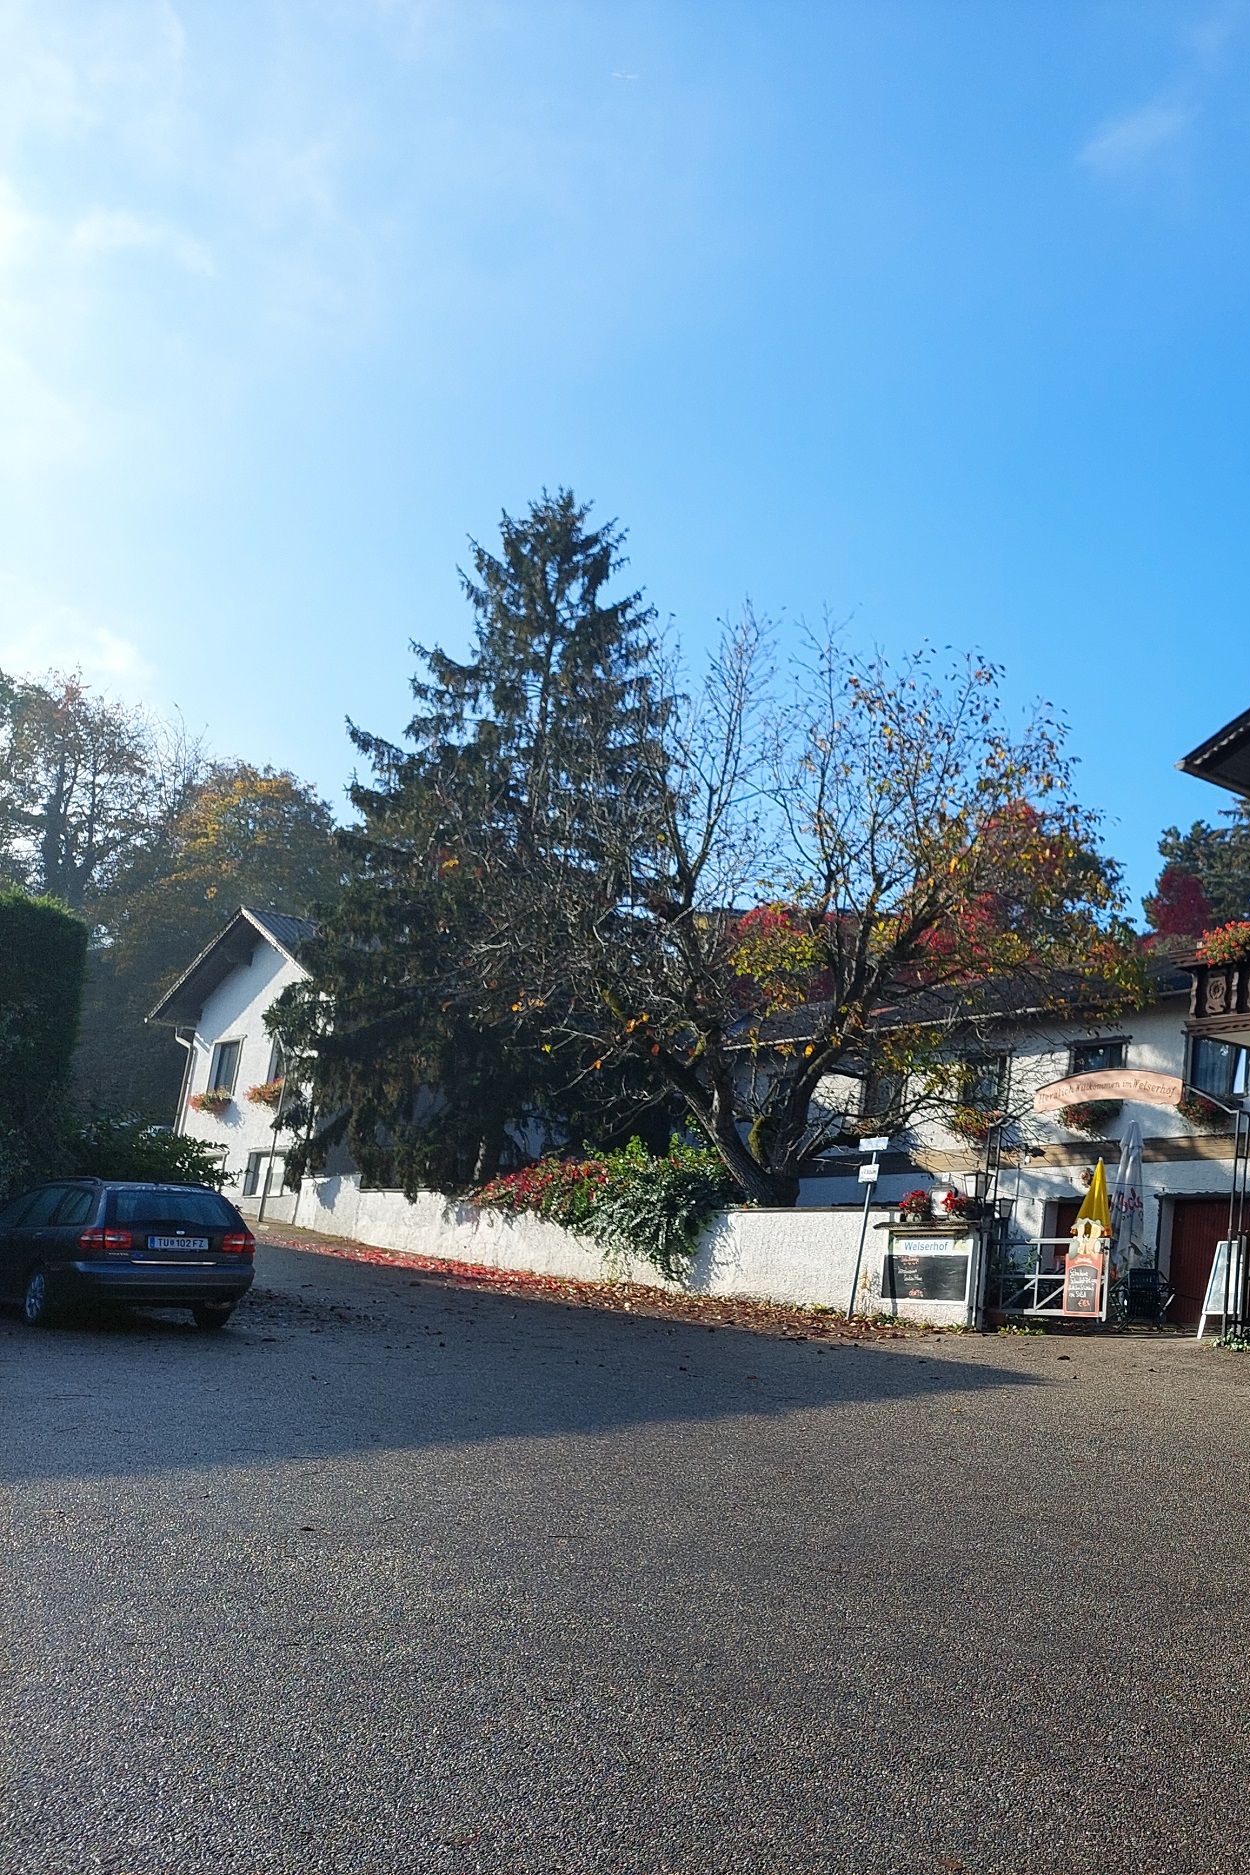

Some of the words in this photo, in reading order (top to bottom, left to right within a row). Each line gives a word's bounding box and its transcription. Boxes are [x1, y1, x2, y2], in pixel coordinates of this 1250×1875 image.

[1038, 1085, 1073, 1102] Herzlich
[1073, 1081, 1120, 1096] Willkommen
[1132, 1077, 1177, 1098] Welserhof
[158, 1238, 172, 1247] TU
[904, 1241, 949, 1251] Welserhof
